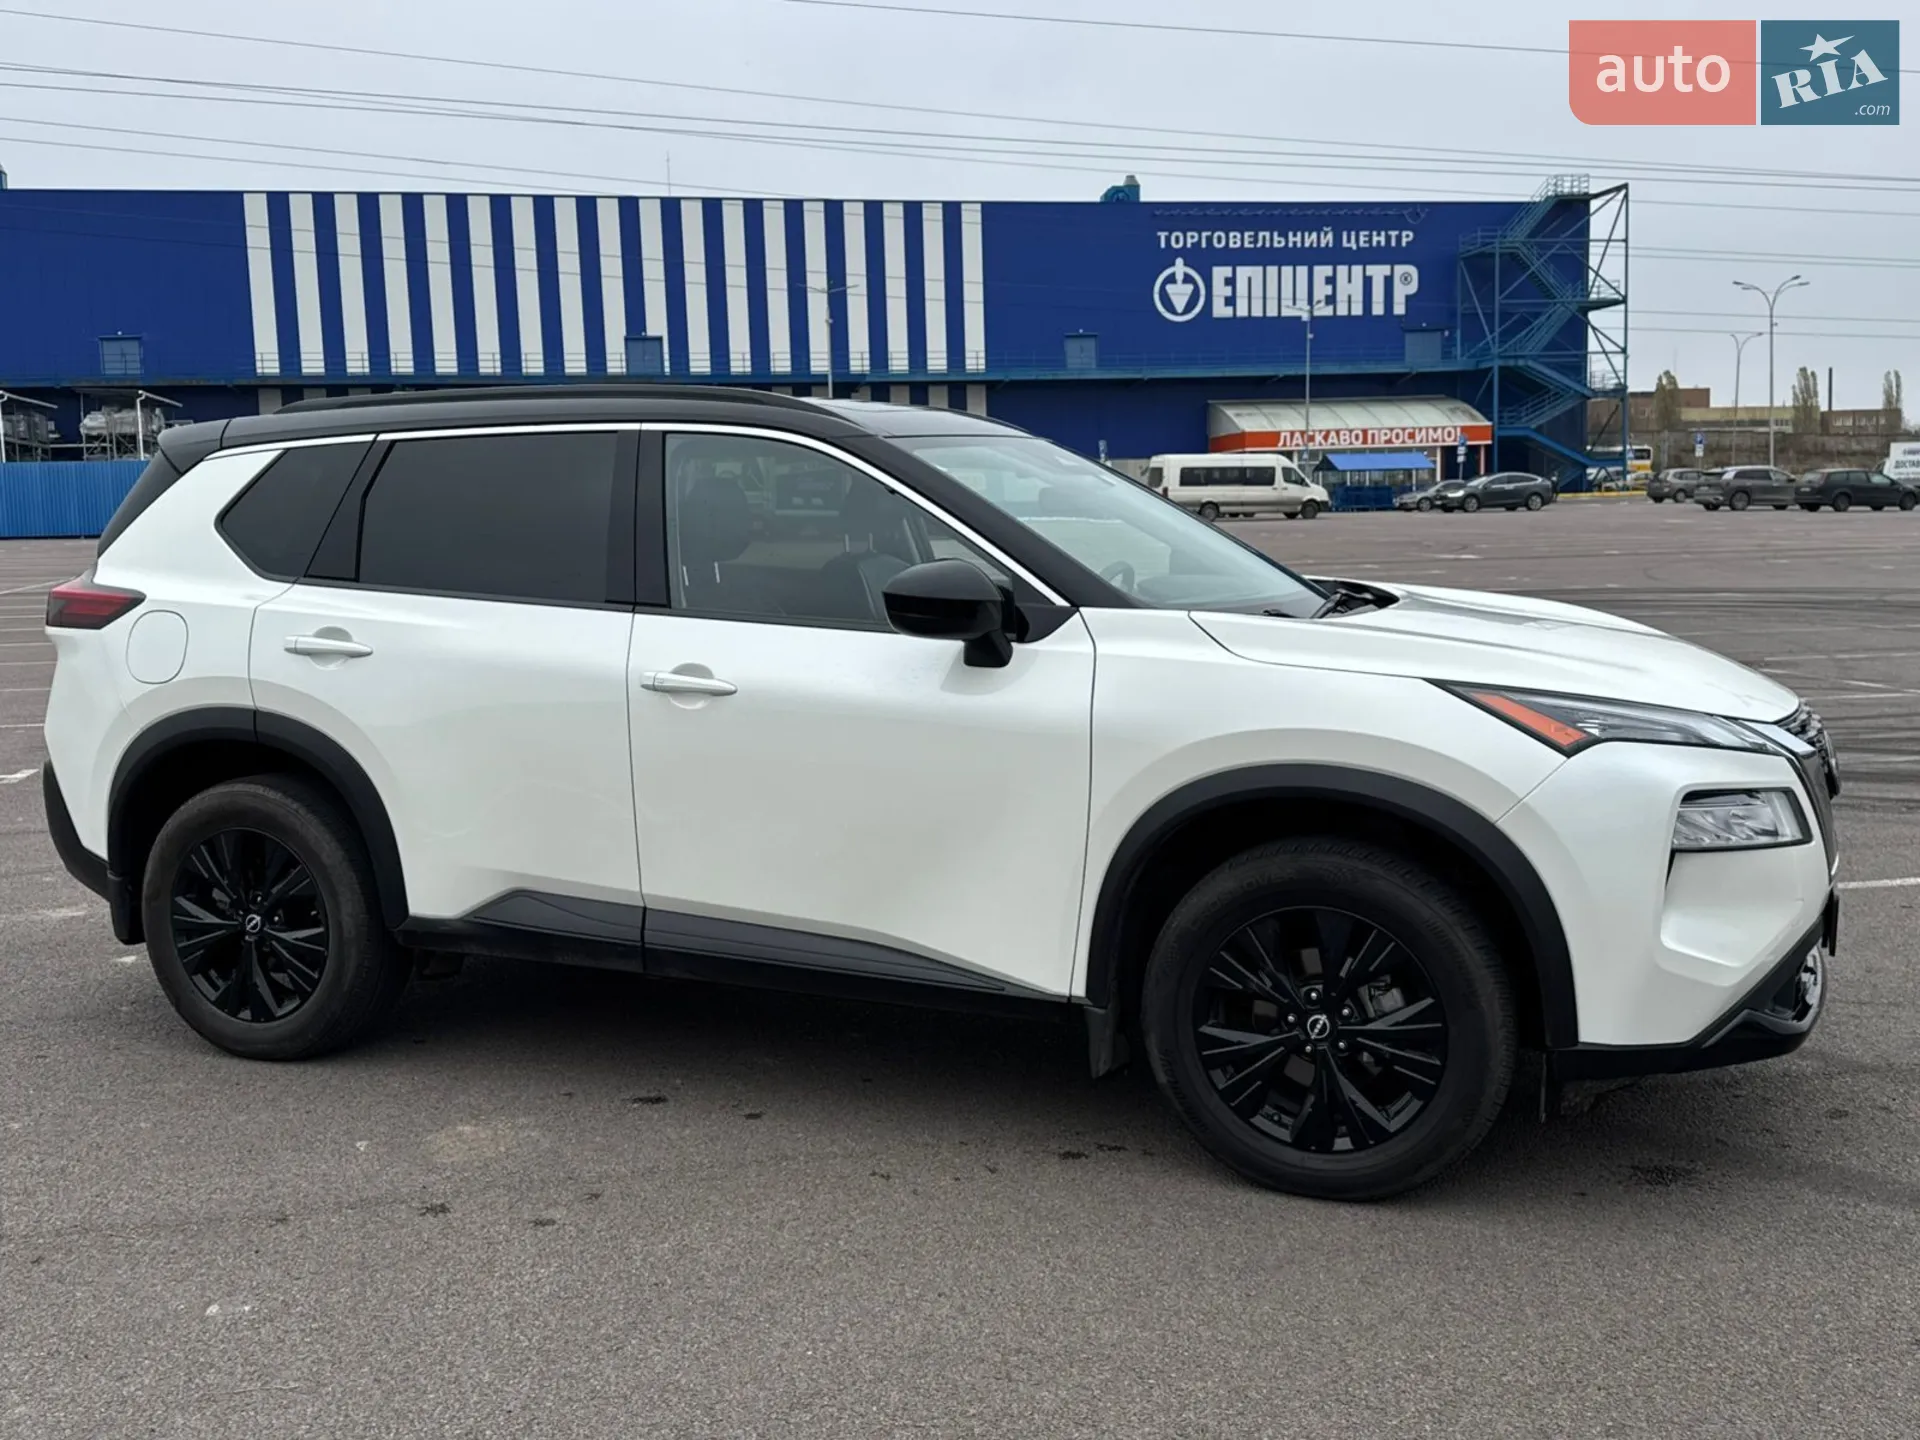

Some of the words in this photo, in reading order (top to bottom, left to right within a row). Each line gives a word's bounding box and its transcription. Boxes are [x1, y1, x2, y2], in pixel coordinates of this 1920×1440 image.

[1157, 227, 1334, 249] ТОРГОВЕЛЬНИЙ
[1342, 230, 1414, 250] ЦЕНТР
[1278, 429, 1363, 447] ЛАСКАВО
[1367, 426, 1461, 445] ПРОСИМО!
